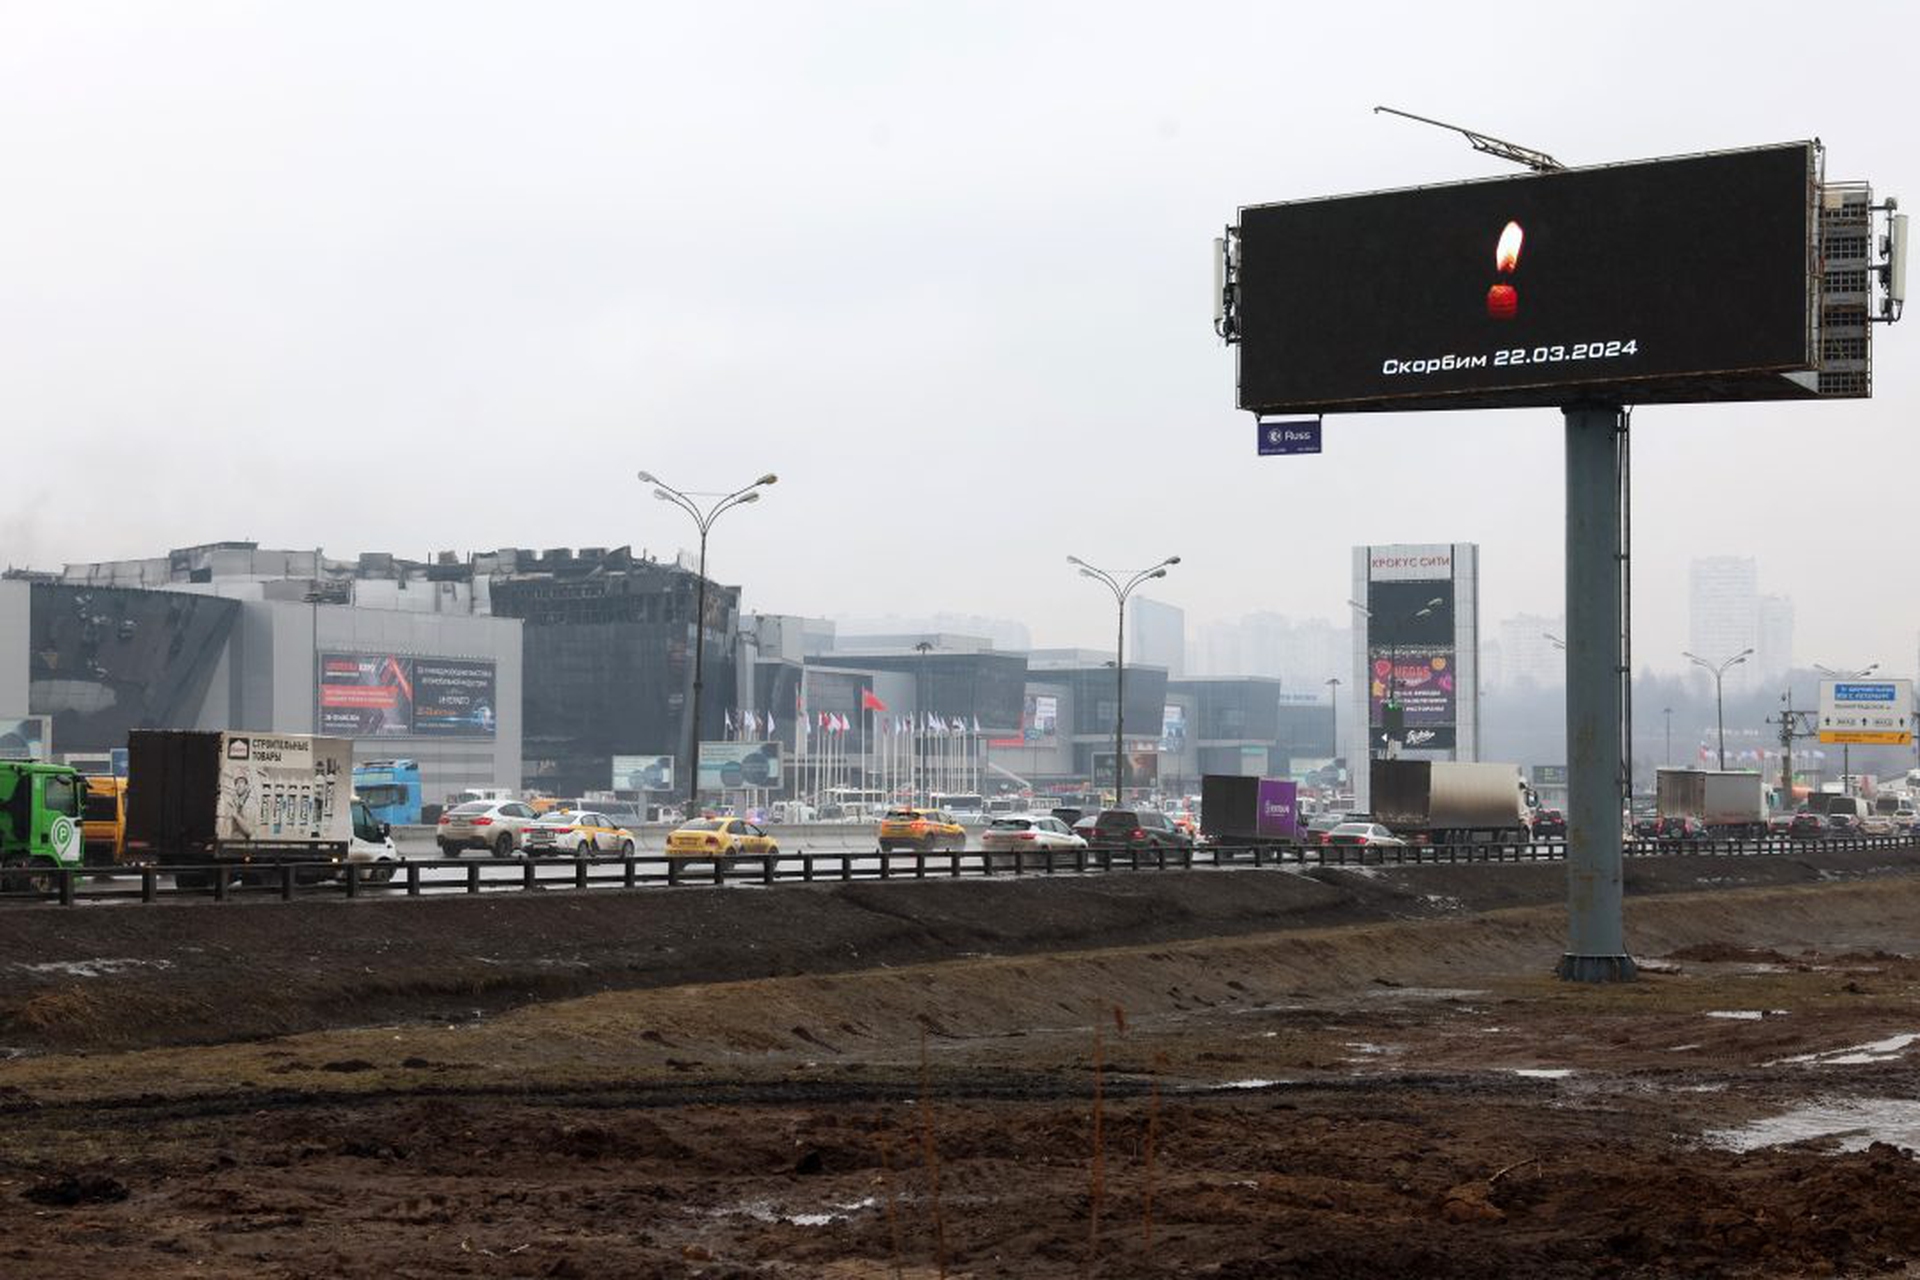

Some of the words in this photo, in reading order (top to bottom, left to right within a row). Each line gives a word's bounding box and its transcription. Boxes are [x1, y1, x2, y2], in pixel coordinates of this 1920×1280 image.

[1382, 354, 1487, 375] Скорбим
[1493, 339, 1638, 366] 22.03.2024
[1284, 430, 1312, 440] Russ
[1372, 557, 1417, 568] КРОКУС
[1420, 556, 1450, 567] СИТИ
[252, 739, 308, 752] СТРОИТЕЛЬНЫЕ
[252, 751, 282, 761] ТОВАРЫ
